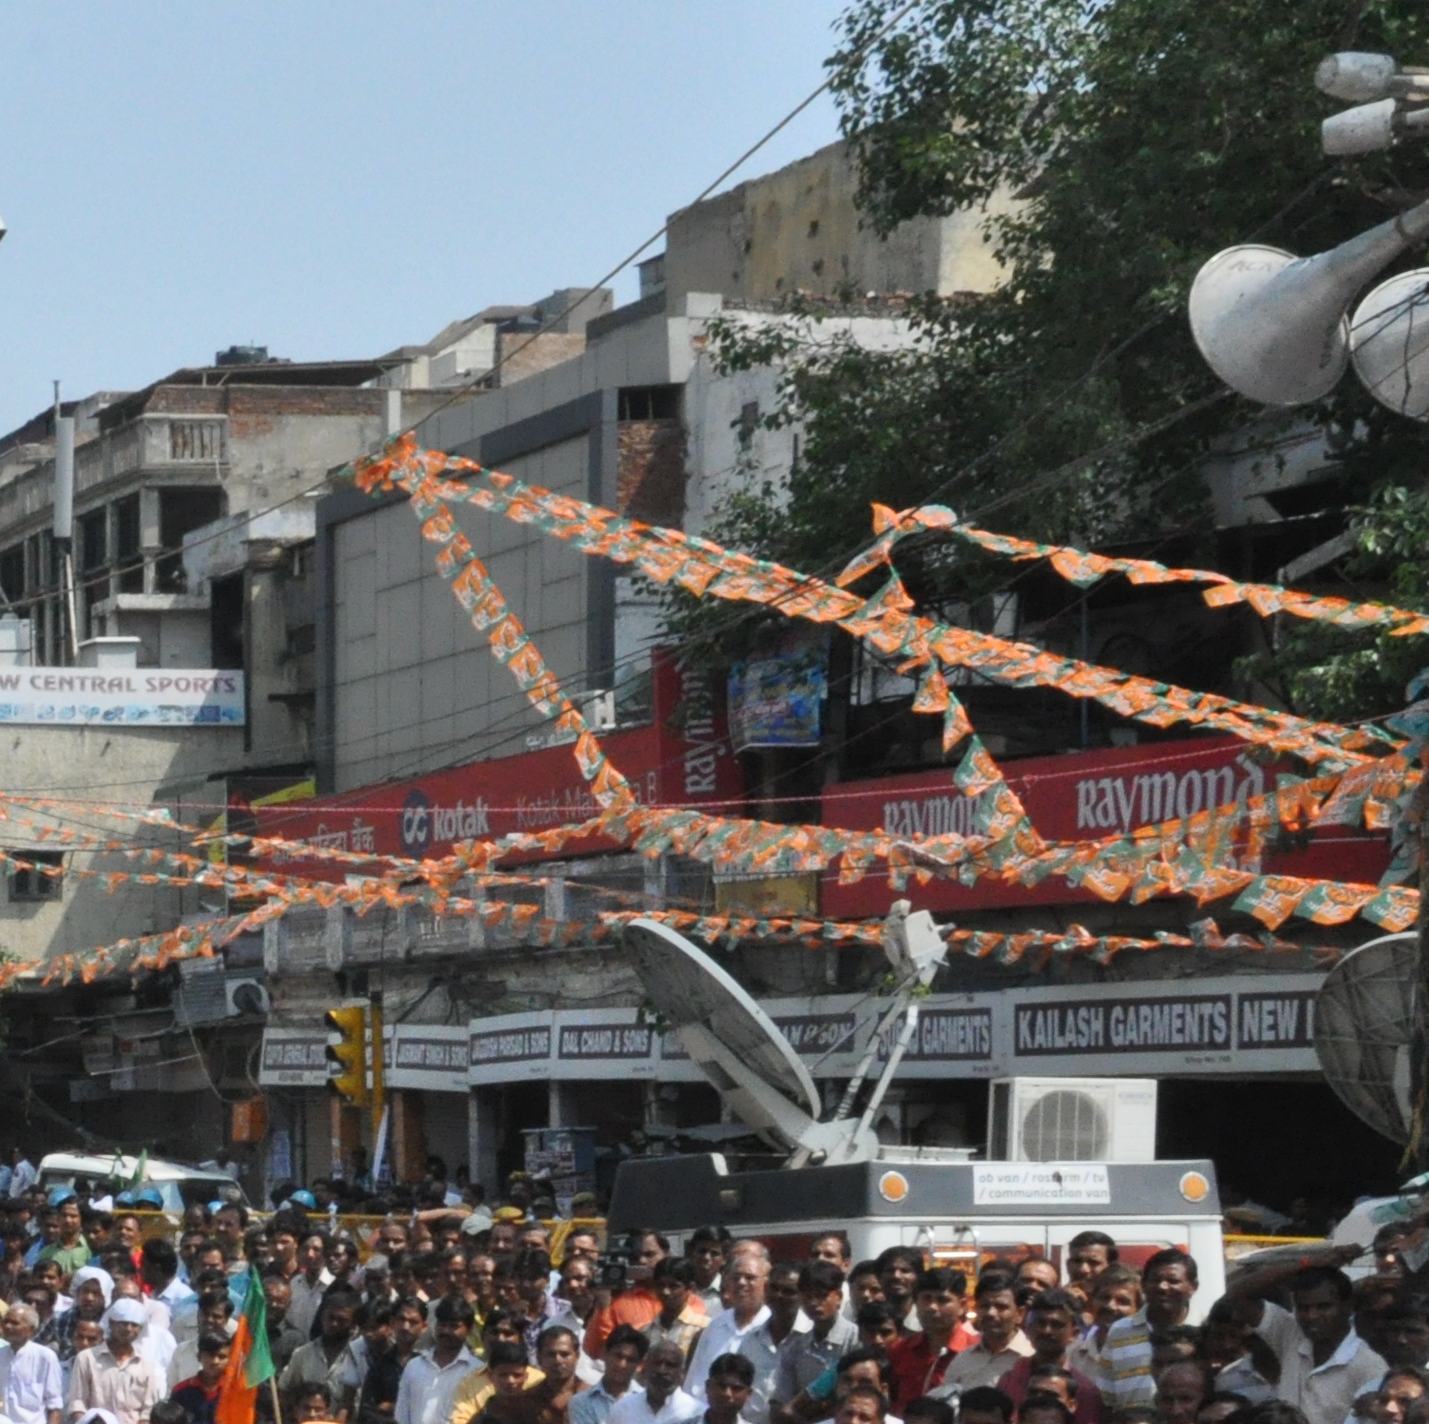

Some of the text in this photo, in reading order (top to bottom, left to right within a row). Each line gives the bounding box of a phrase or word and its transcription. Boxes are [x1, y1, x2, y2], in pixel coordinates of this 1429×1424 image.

[29, 674, 137, 693] CENTRAL
[145, 676, 237, 695] SPORTS
[433, 797, 490, 842] kotak
[517, 789, 561, 827] Kotak
[922, 1013, 991, 1055] GARMENTS
[1018, 1001, 1228, 1050] KAILASH GARMENTS
[1242, 998, 1300, 1042] NEW
[580, 1030, 613, 1053] CHAND
[622, 1029, 649, 1053] SONS
[979, 1171, 994, 1183] ob
[996, 1173, 1020, 1183] van
[1093, 1173, 1106, 1183] tv
[988, 1188, 1083, 1199] communication
[1086, 1189, 1108, 1198] van
